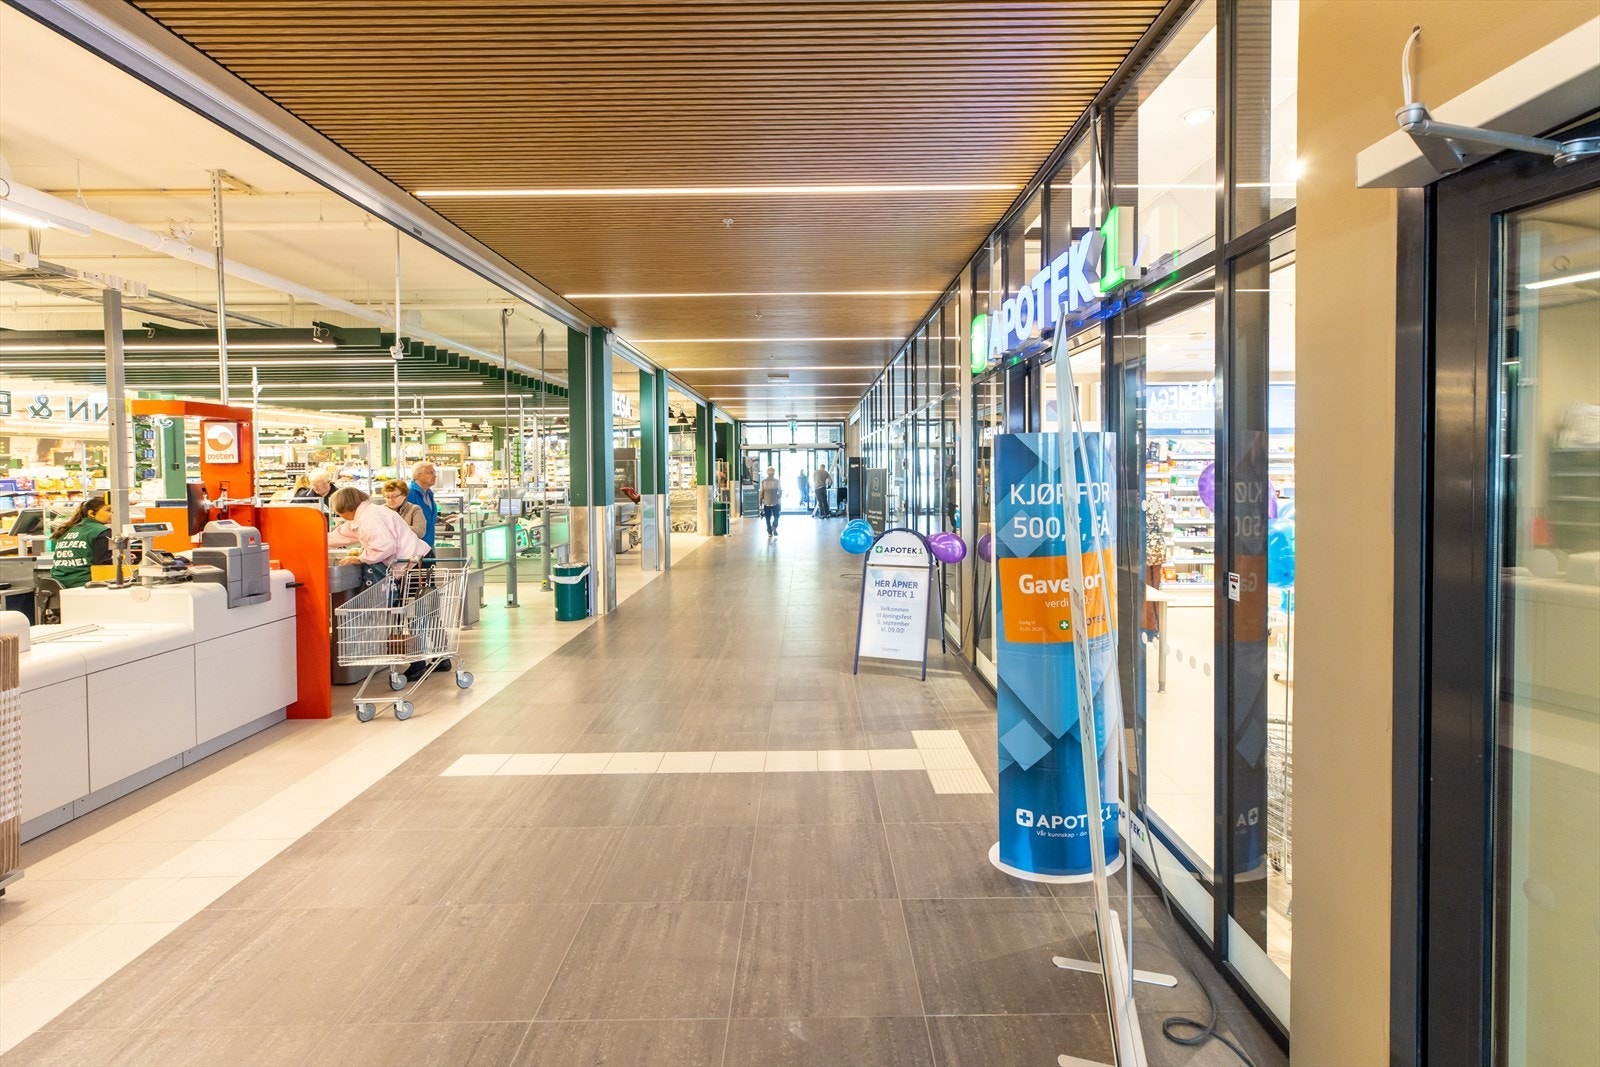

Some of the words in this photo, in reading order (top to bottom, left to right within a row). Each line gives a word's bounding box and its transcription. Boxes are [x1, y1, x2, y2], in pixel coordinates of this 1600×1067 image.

[988, 230, 1096, 360] APOTEK
[1100, 205, 1126, 293] 1
[611, 391, 632, 418] EGA
[207, 452, 235, 460] posten
[1077, 482, 1110, 505] FOR
[63, 532, 79, 540] JEG
[56, 550, 74, 558] DEG
[884, 546, 918, 555] APOTEK
[874, 580, 890, 588] HER
[892, 579, 919, 589] ÅPNER
[876, 590, 907, 598] APOTEK
[1045, 598, 1070, 608] verdi
[880, 605, 909, 613] Velkommen
